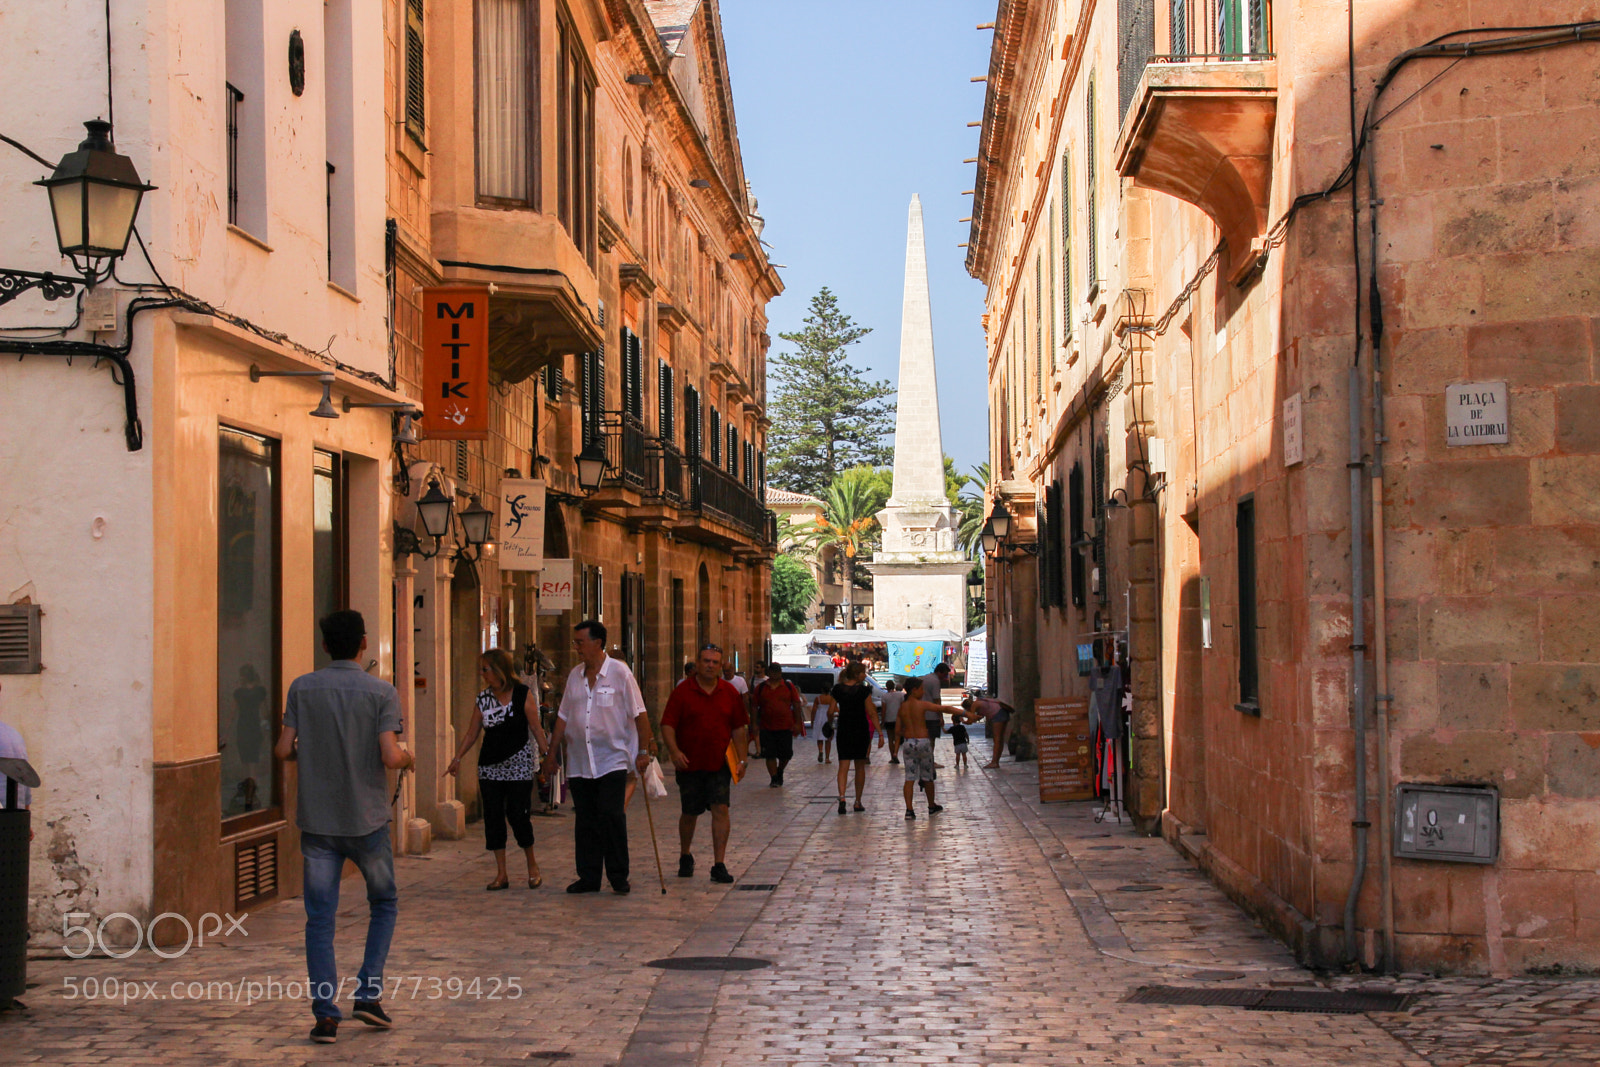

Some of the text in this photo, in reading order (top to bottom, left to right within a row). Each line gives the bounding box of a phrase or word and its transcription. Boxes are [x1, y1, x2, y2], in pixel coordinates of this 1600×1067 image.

[437, 302, 474, 398] MITIK
[1459, 392, 1496, 406] PLAÇA
[1470, 409, 1483, 420] DE
[1448, 423, 1507, 437] LA CATEDRAL
[542, 581, 571, 593] RIA
